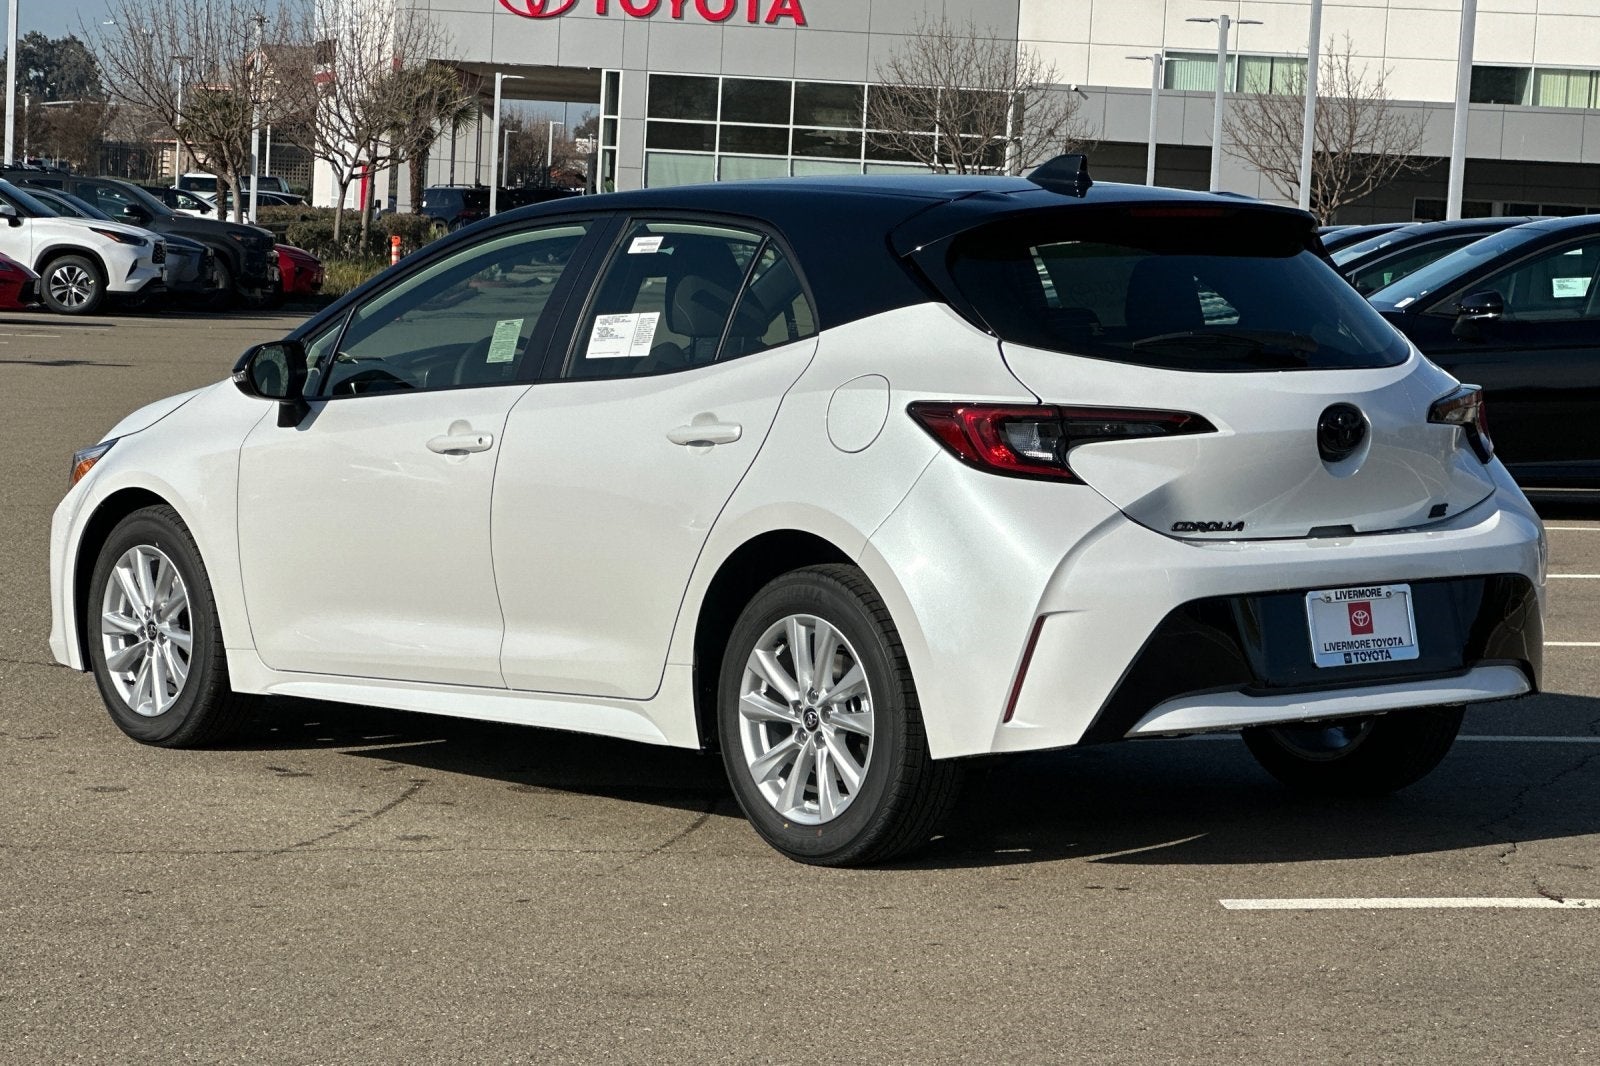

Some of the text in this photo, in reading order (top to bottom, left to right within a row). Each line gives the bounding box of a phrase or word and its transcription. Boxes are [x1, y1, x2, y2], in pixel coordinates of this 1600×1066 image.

[1171, 521, 1245, 532] COROLLA
[1335, 588, 1382, 600] LIVERMORE
[1324, 637, 1404, 651] LIVERMORE TOYOTA
[1354, 650, 1392, 663] TOYOTA
